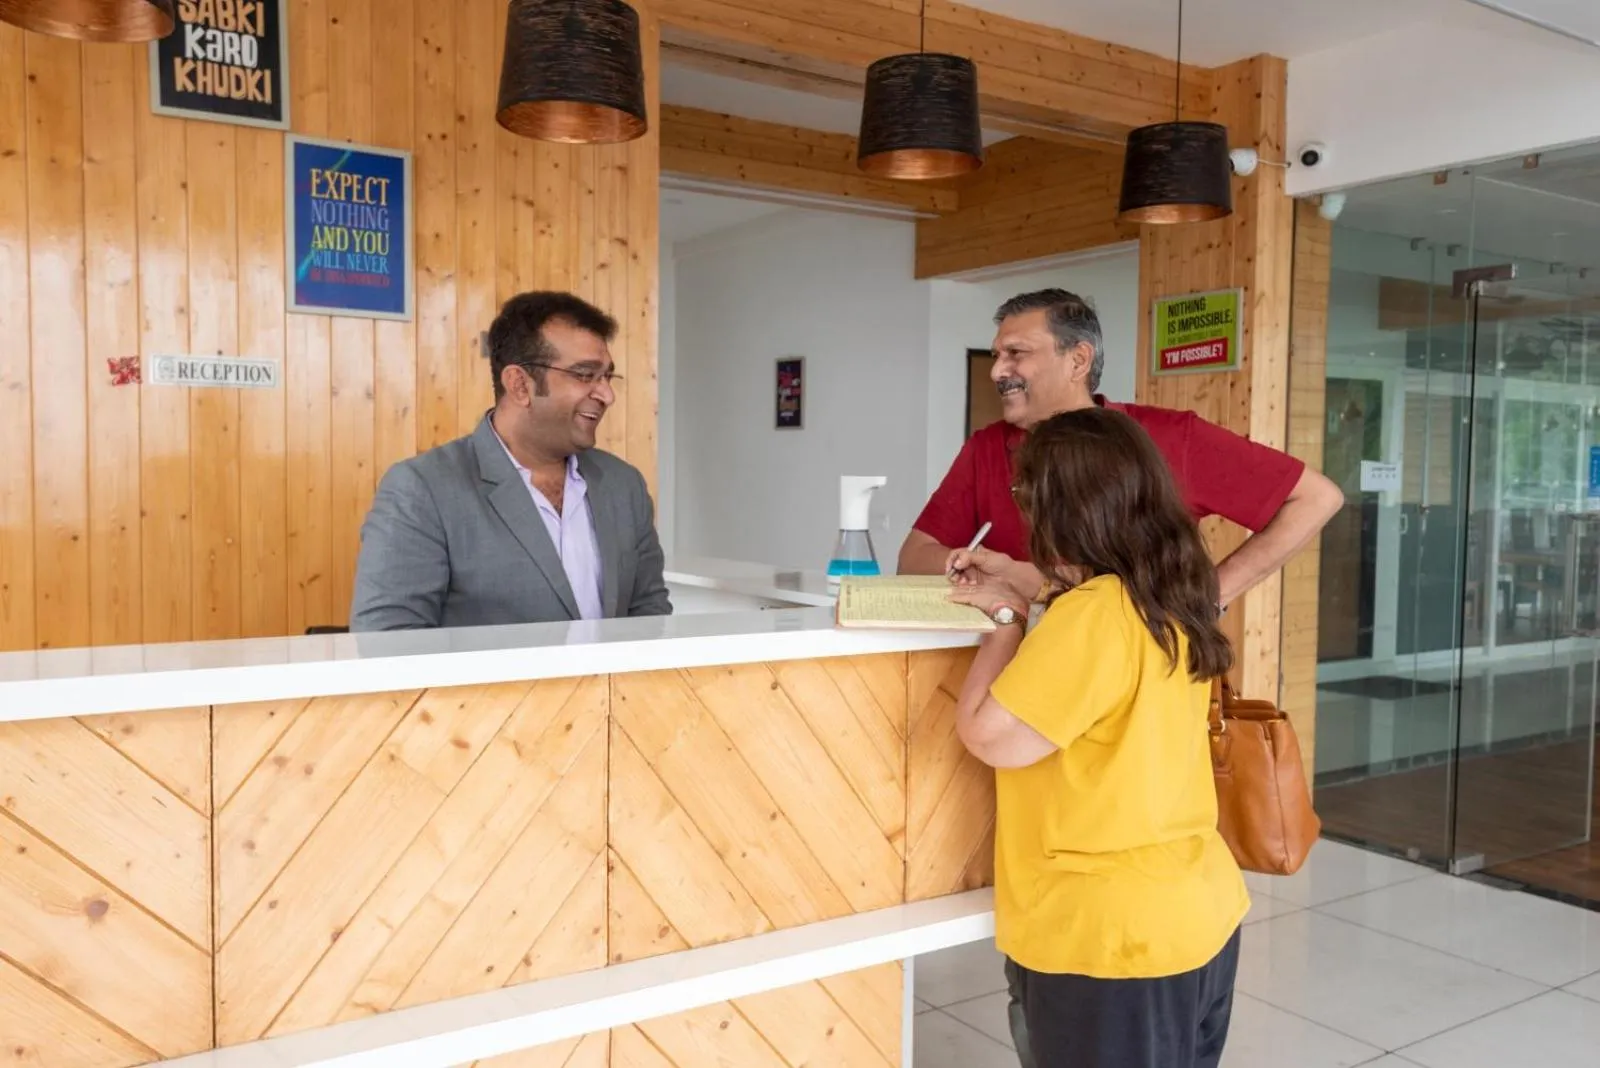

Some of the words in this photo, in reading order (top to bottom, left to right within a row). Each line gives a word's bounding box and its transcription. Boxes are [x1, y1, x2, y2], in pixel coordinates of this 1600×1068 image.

[178, 0, 265, 38] SABKI
[174, 56, 272, 104] KHUDKI
[310, 168, 390, 207] EXPECT
[311, 200, 390, 231] NOTHING
[312, 225, 349, 251] AND
[352, 229, 390, 256] YOU
[312, 249, 344, 270] WILL
[346, 253, 390, 275] NEVER
[1168, 296, 1206, 319] NOTHING
[1168, 319, 1176, 336] IS
[177, 361, 273, 383] RECEPTION
